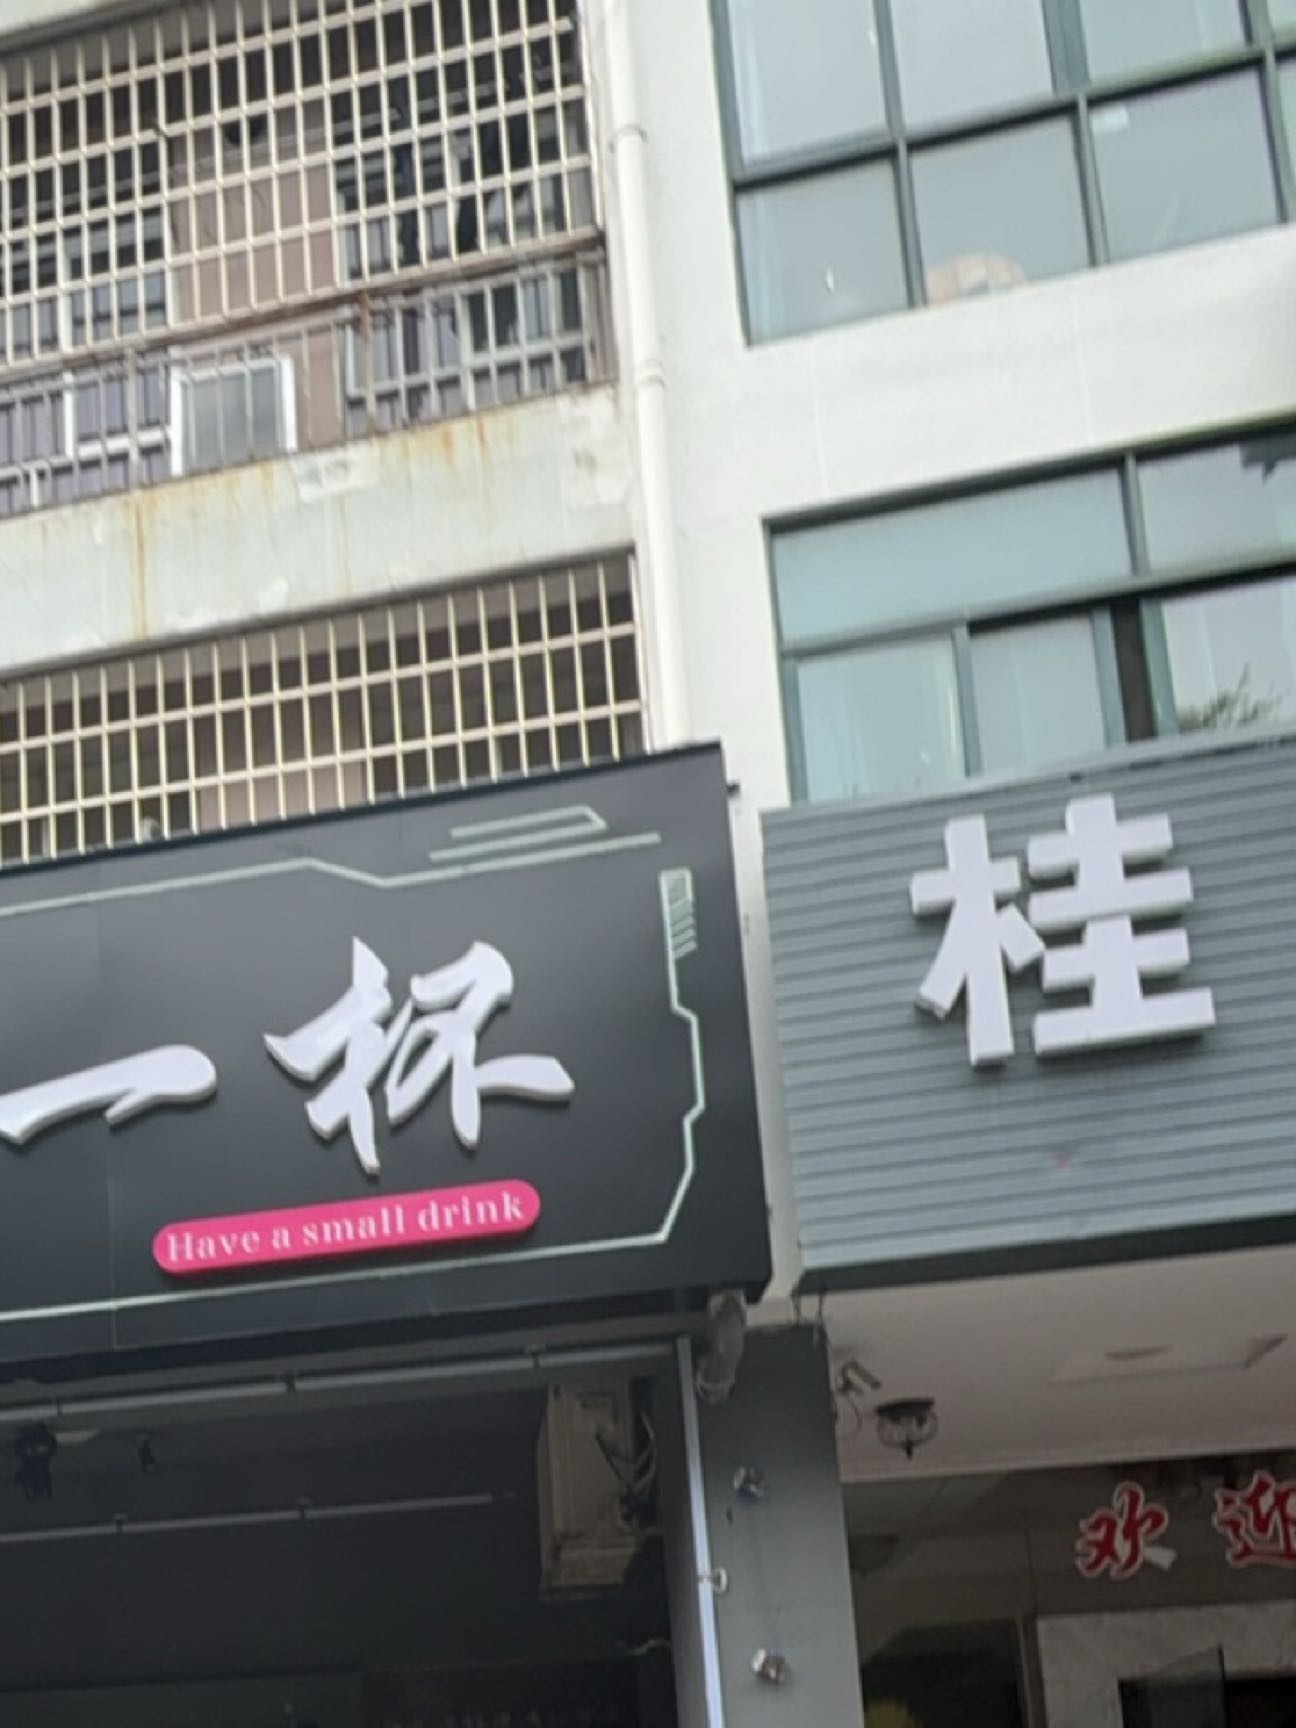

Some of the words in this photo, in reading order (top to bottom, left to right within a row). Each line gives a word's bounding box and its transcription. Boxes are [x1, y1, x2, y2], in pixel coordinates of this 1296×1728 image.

[908, 790, 1218, 1066] 桂
[167, 1230, 261, 1264] Have
[270, 1227, 292, 1250] a
[301, 1206, 406, 1247] small
[417, 1190, 526, 1233] drink
